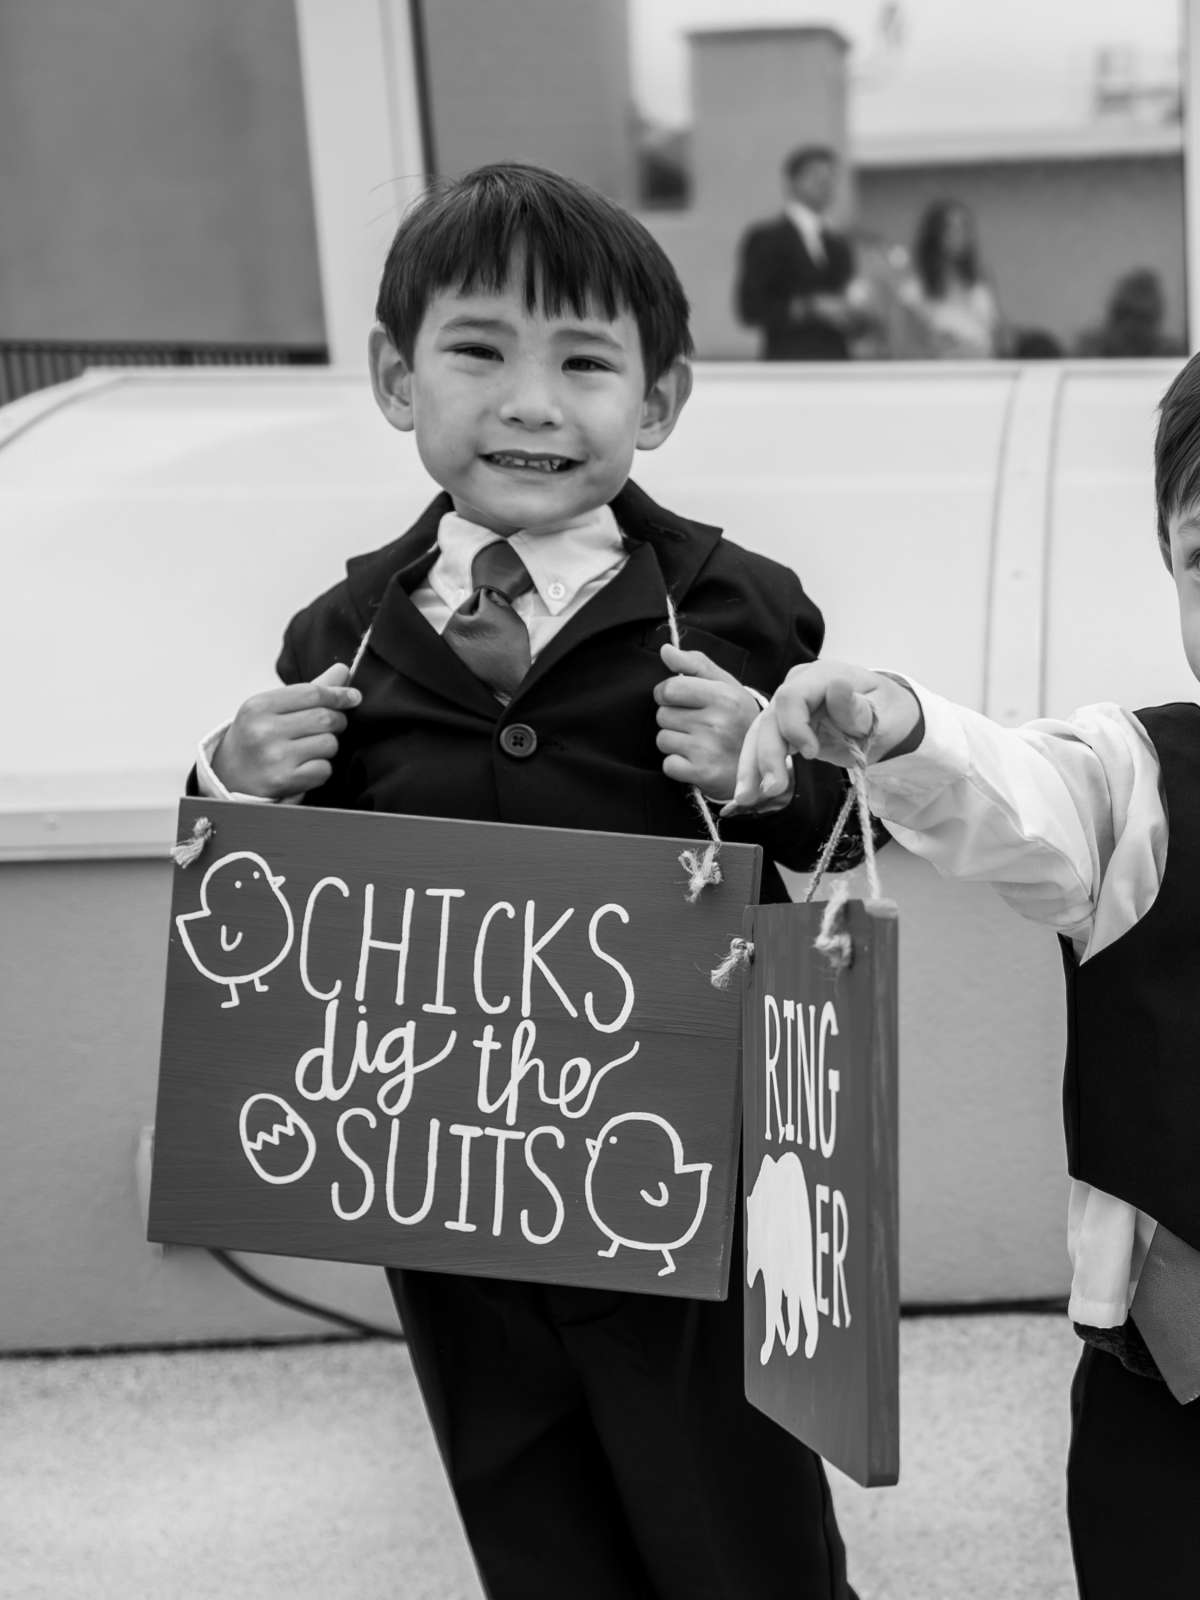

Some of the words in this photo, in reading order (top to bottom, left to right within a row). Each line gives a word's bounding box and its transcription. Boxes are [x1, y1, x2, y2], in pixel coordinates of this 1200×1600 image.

[299, 876, 634, 1033] CHICKS
[295, 999, 457, 1115] dig
[472, 1018, 640, 1125] the
[764, 994, 840, 1159] RING
[331, 1107, 565, 1244] SUITS
